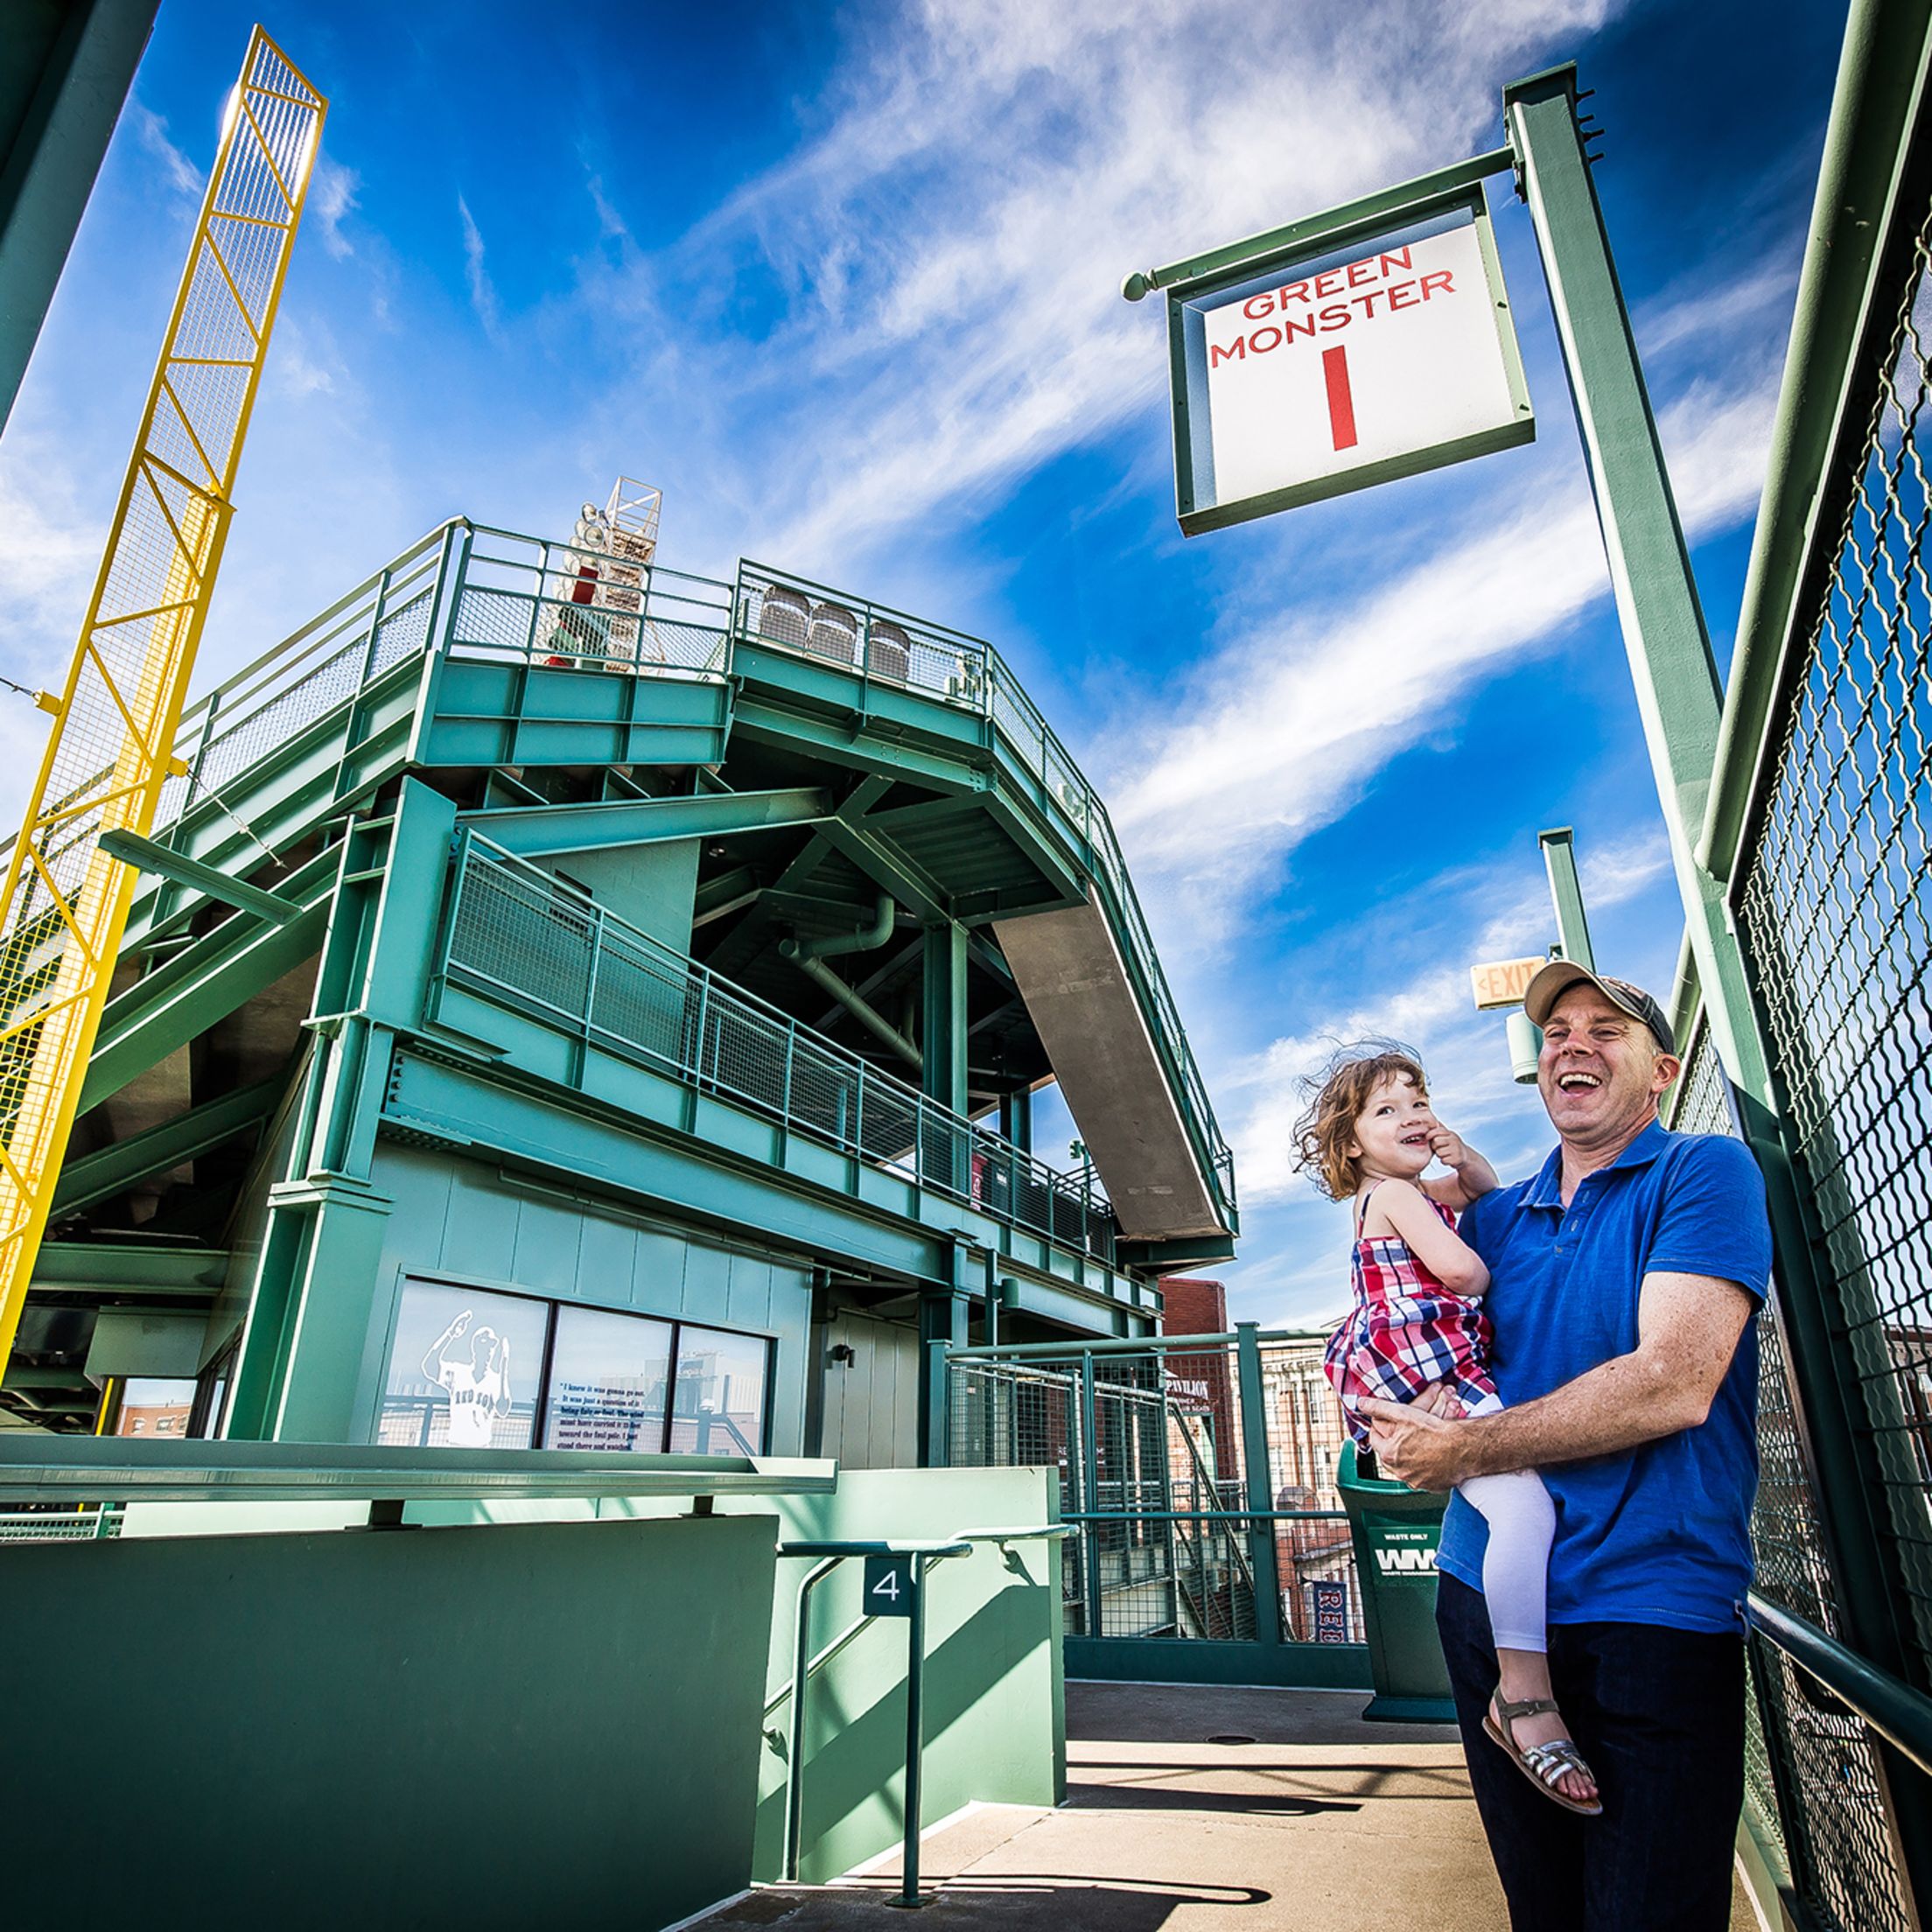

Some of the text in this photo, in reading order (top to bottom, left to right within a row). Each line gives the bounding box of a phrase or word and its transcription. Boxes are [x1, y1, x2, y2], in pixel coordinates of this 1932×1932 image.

[1242, 245, 1412, 320] GREEN
[1210, 270, 1456, 368] MONSTER
[1487, 962, 1535, 998] EXIT
[606, 1388, 625, 1396] gonna
[1166, 1379, 1208, 1400] PAVILION
[561, 1405, 579, 1416] being
[593, 1419, 615, 1428] carried
[626, 1432, 638, 1441] just
[872, 1570, 900, 1601] 4
[1318, 1589, 1345, 1643] RED
